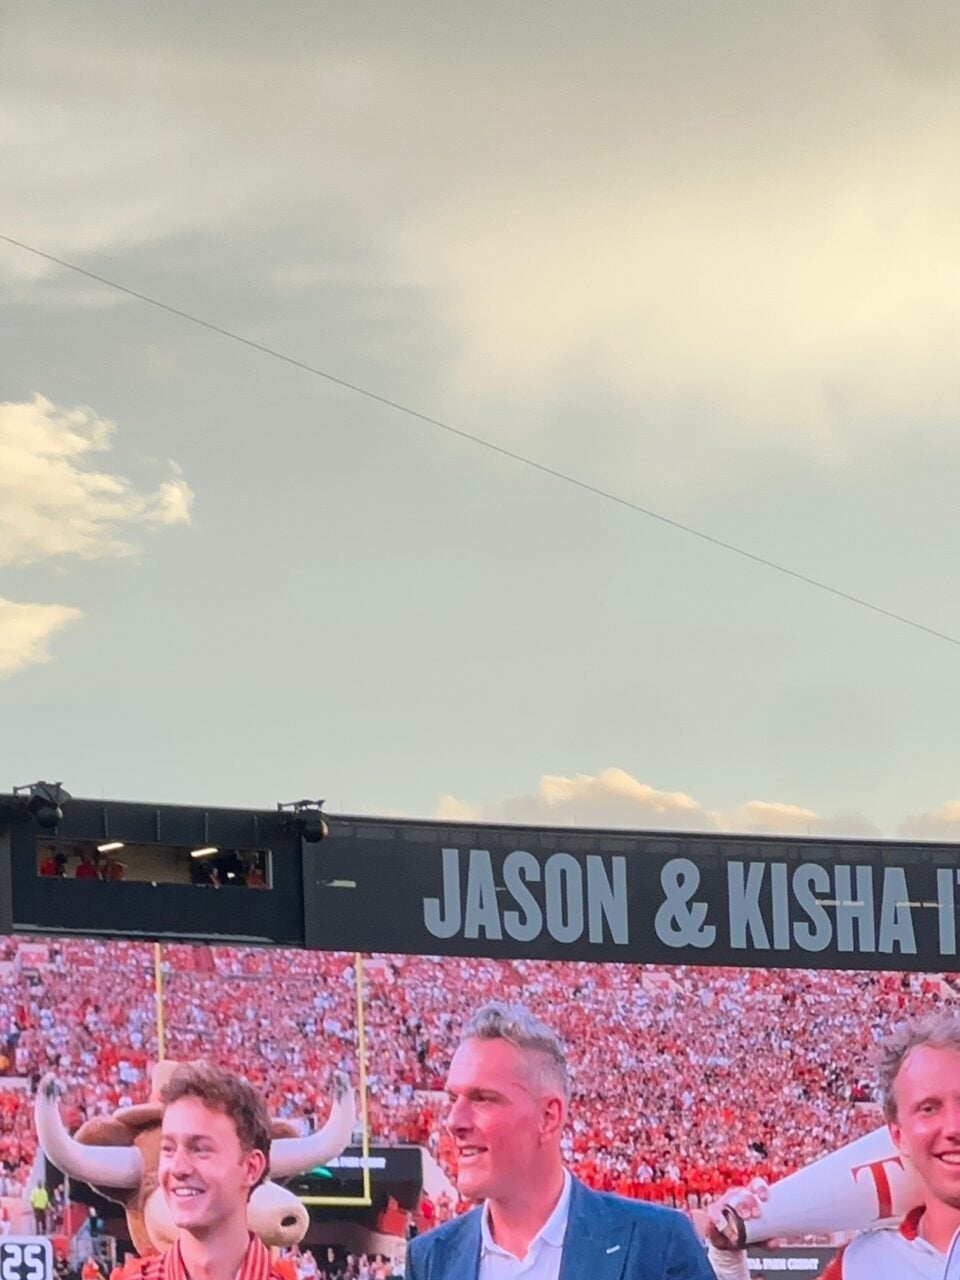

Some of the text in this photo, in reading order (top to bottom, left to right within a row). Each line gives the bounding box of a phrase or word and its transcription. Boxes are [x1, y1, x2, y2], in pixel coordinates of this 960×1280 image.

[423, 848, 960, 955] JASON & KISHA I
[851, 1156, 905, 1220] T
[2, 1244, 44, 1280] 25
